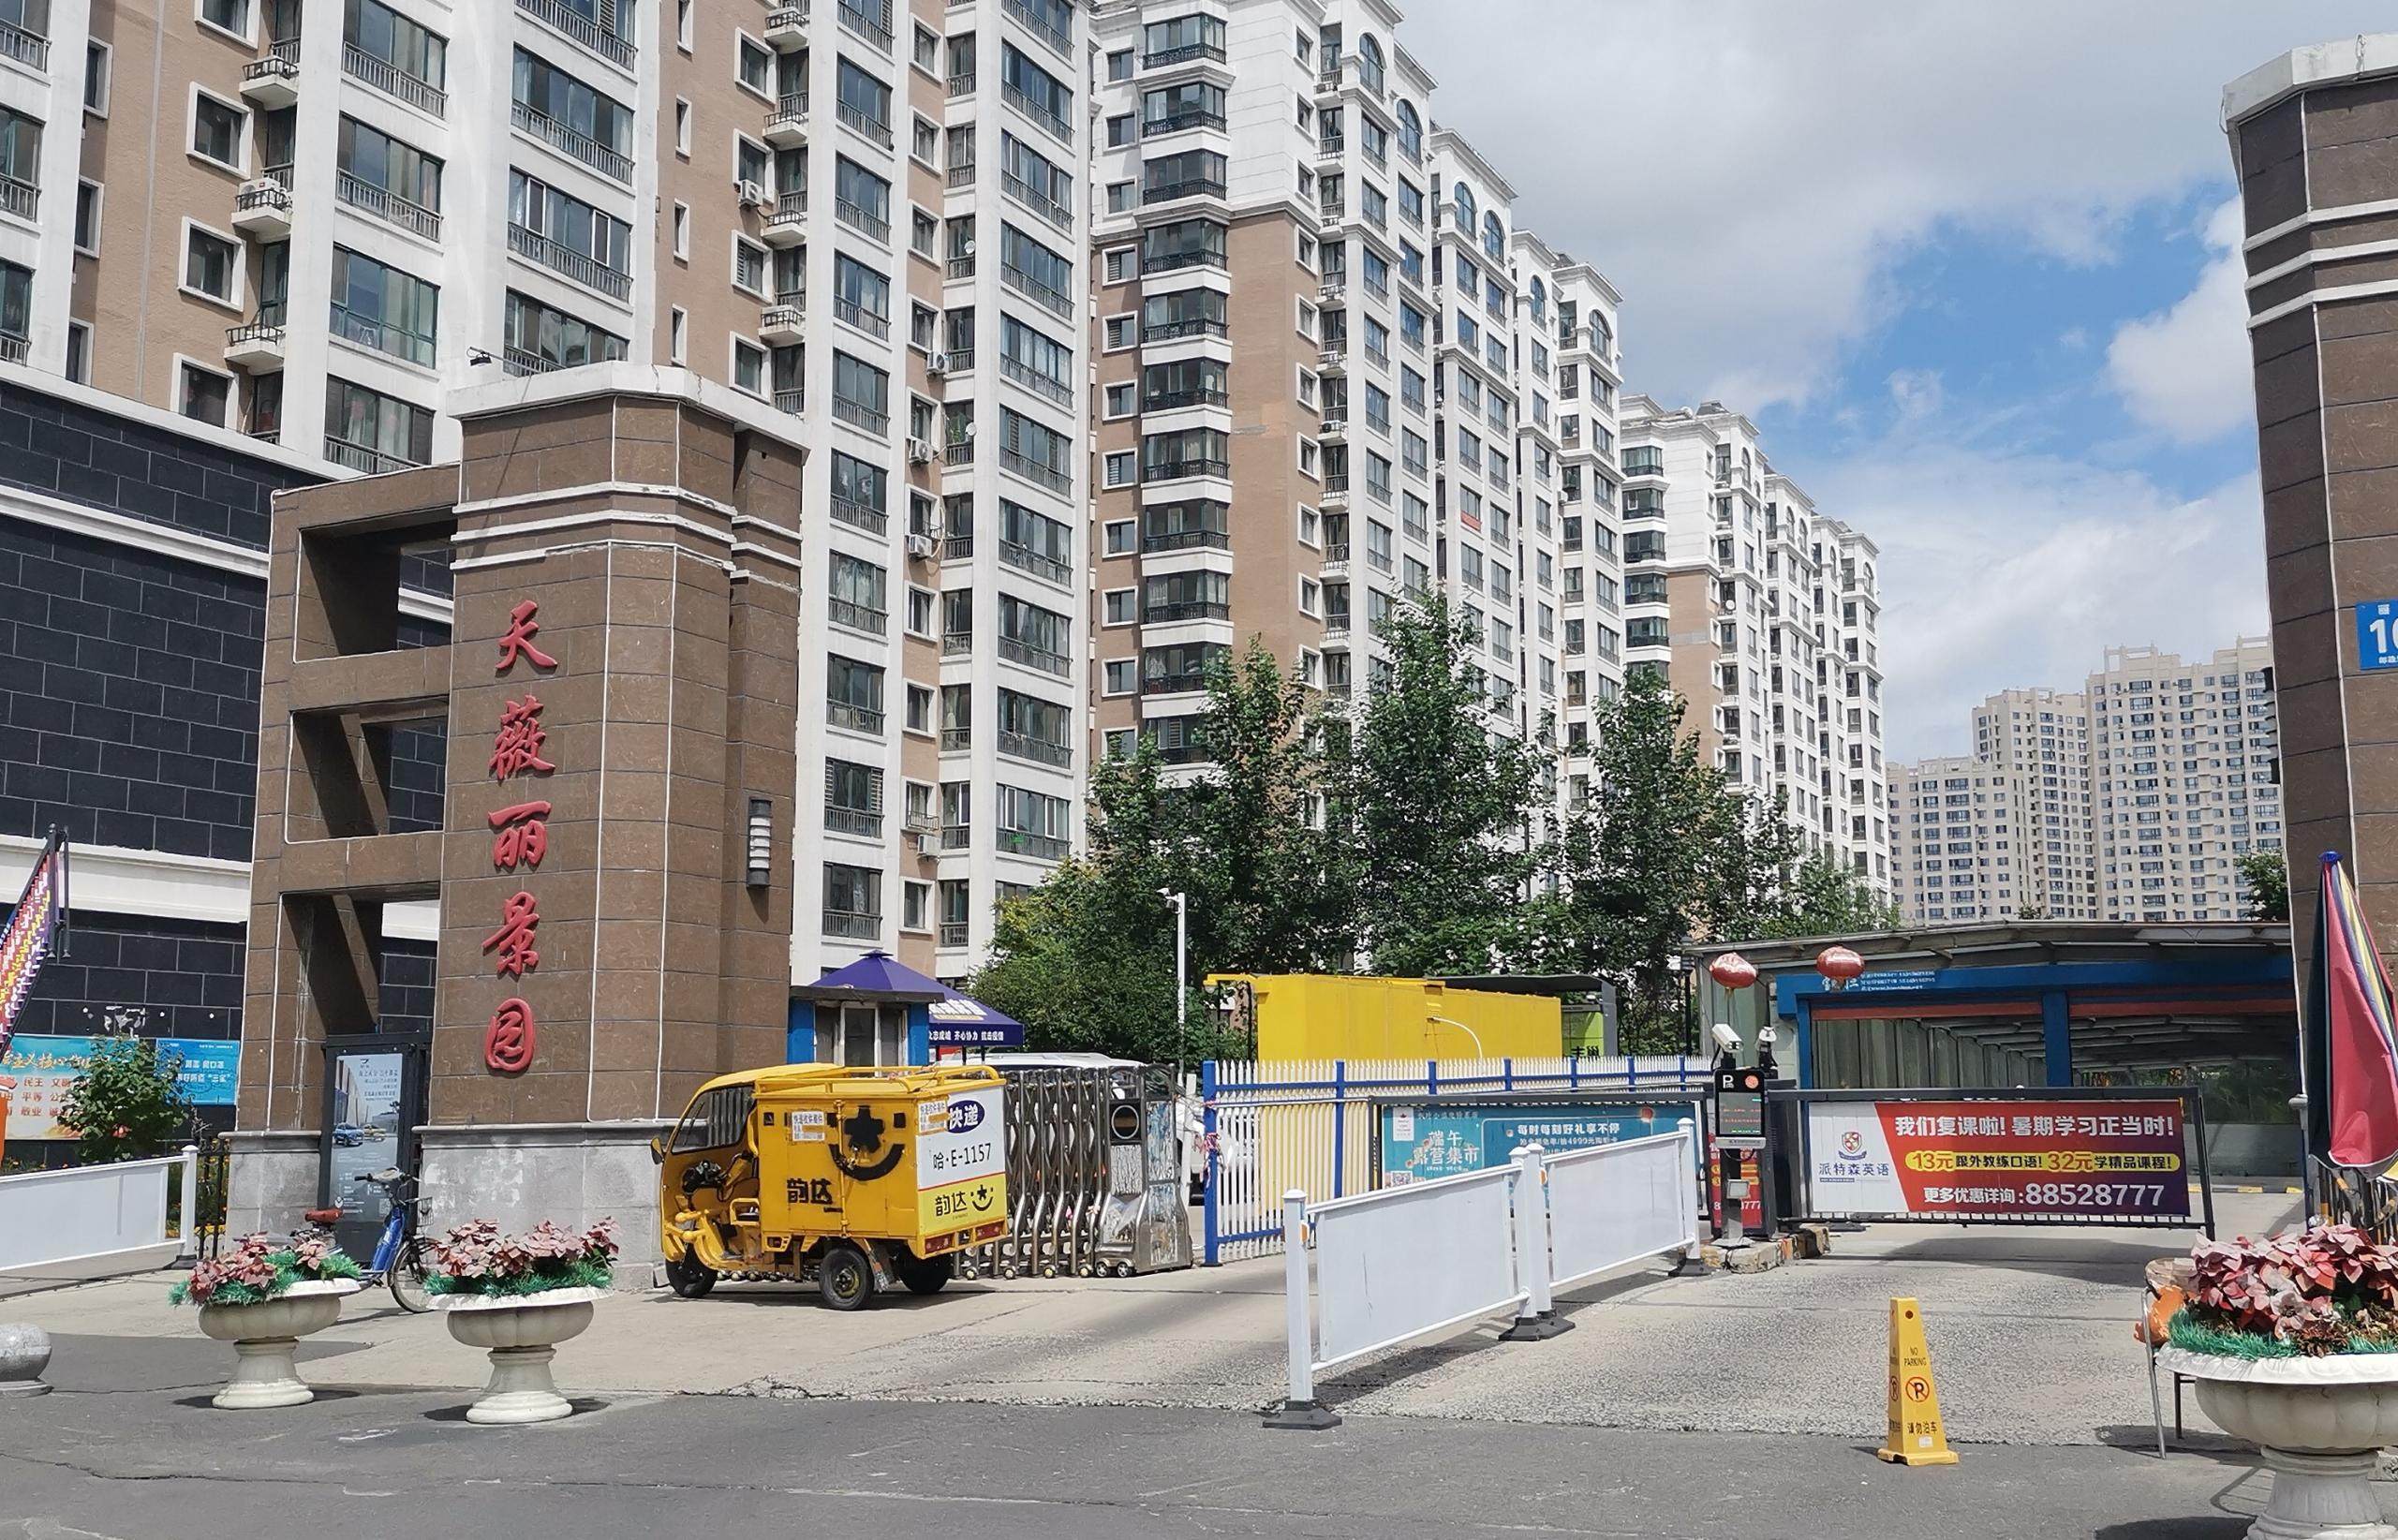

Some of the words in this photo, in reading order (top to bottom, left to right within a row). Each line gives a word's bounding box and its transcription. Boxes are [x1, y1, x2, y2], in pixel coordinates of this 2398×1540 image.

[483, 599, 558, 1070] 天薇丽景园
[949, 1103, 979, 1131] 快递
[1517, 1122, 1621, 1135] 每时每刻好礼享不停
[1428, 1130, 1463, 1147] 端午
[1818, 1162, 1889, 1177] 派特森英语
[786, 1177, 834, 1206] 韵达
[934, 1190, 968, 1217] 韵达
[1909, 1347, 1918, 1355] NO
[1903, 1357, 1927, 1367] PARKING
[1907, 1421, 1938, 1434] 请勿泊车
